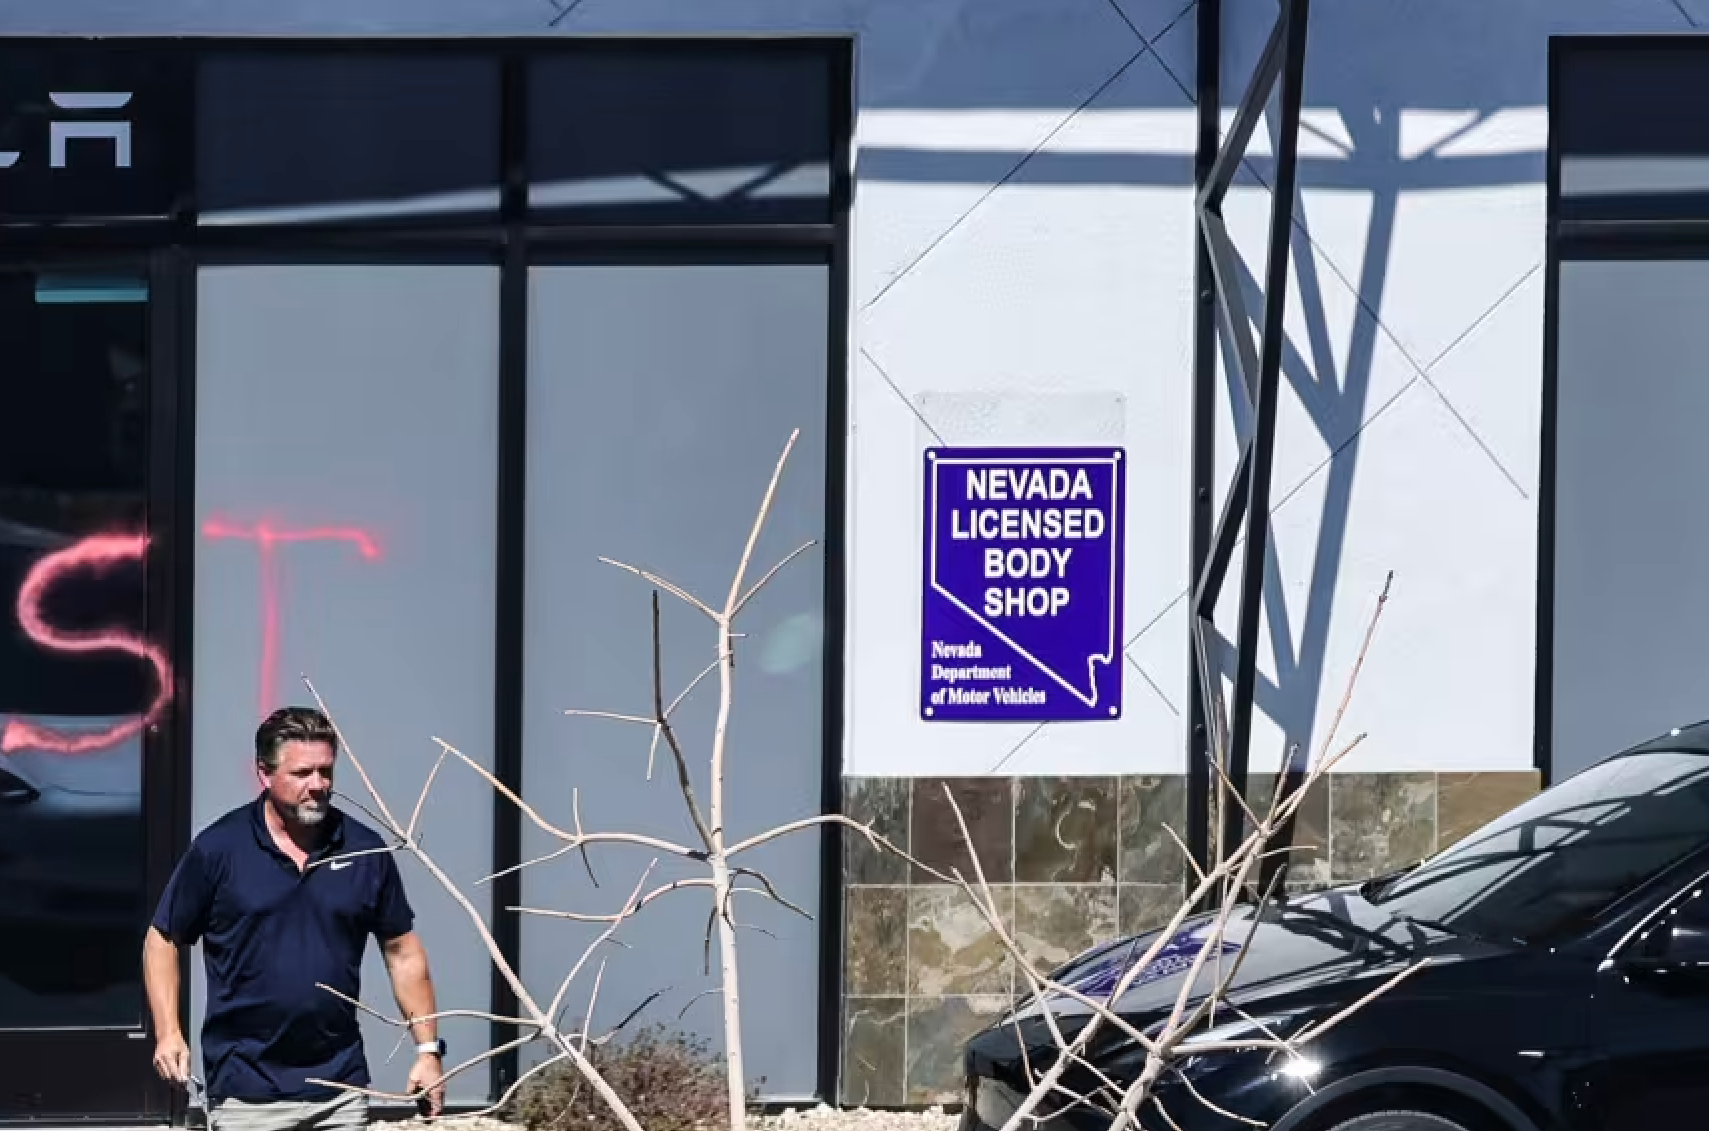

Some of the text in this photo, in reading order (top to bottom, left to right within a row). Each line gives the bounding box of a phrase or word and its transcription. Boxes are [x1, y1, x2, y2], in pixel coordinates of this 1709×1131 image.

[966, 467, 1094, 501] NEVADA
[951, 508, 1106, 541] LICENSED
[984, 548, 1074, 579] BODY
[984, 587, 1071, 618] SHOP
[931, 640, 983, 659] Nevada
[931, 664, 1012, 684] Department
[931, 686, 1046, 705] of Motor Vehicles
